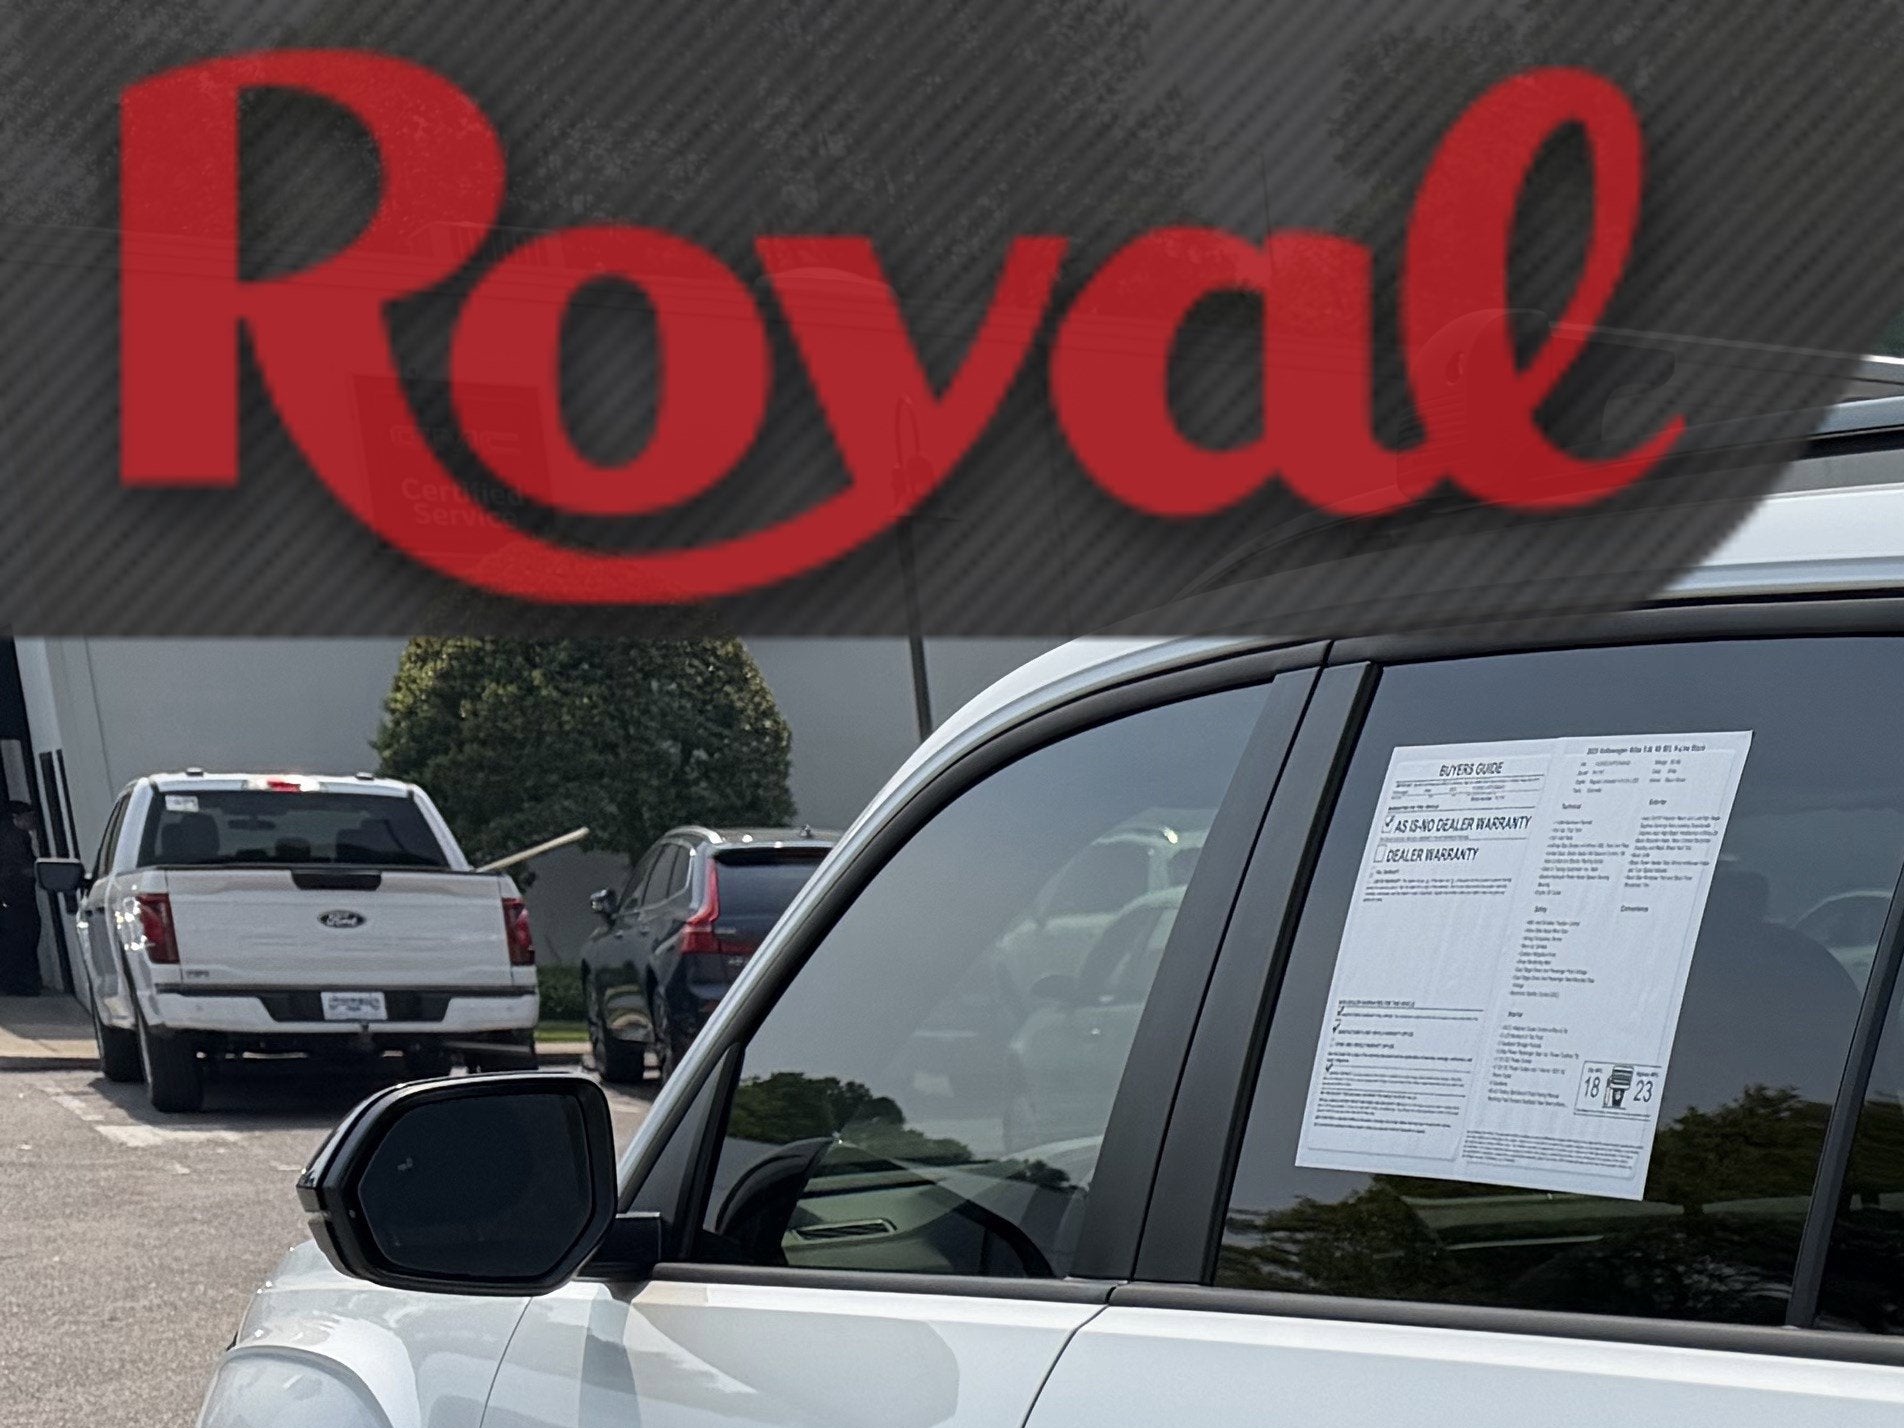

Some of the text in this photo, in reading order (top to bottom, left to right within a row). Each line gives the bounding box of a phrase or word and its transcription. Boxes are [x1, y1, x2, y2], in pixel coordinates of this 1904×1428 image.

[1439, 761, 1504, 777] BUYERS GUIDE
[1436, 817, 1475, 832] DEALER
[1476, 815, 1532, 831] WARRANTY
[1386, 847, 1479, 862] DEALER WARRANTY
[1584, 1076, 1654, 1103] 18 23
